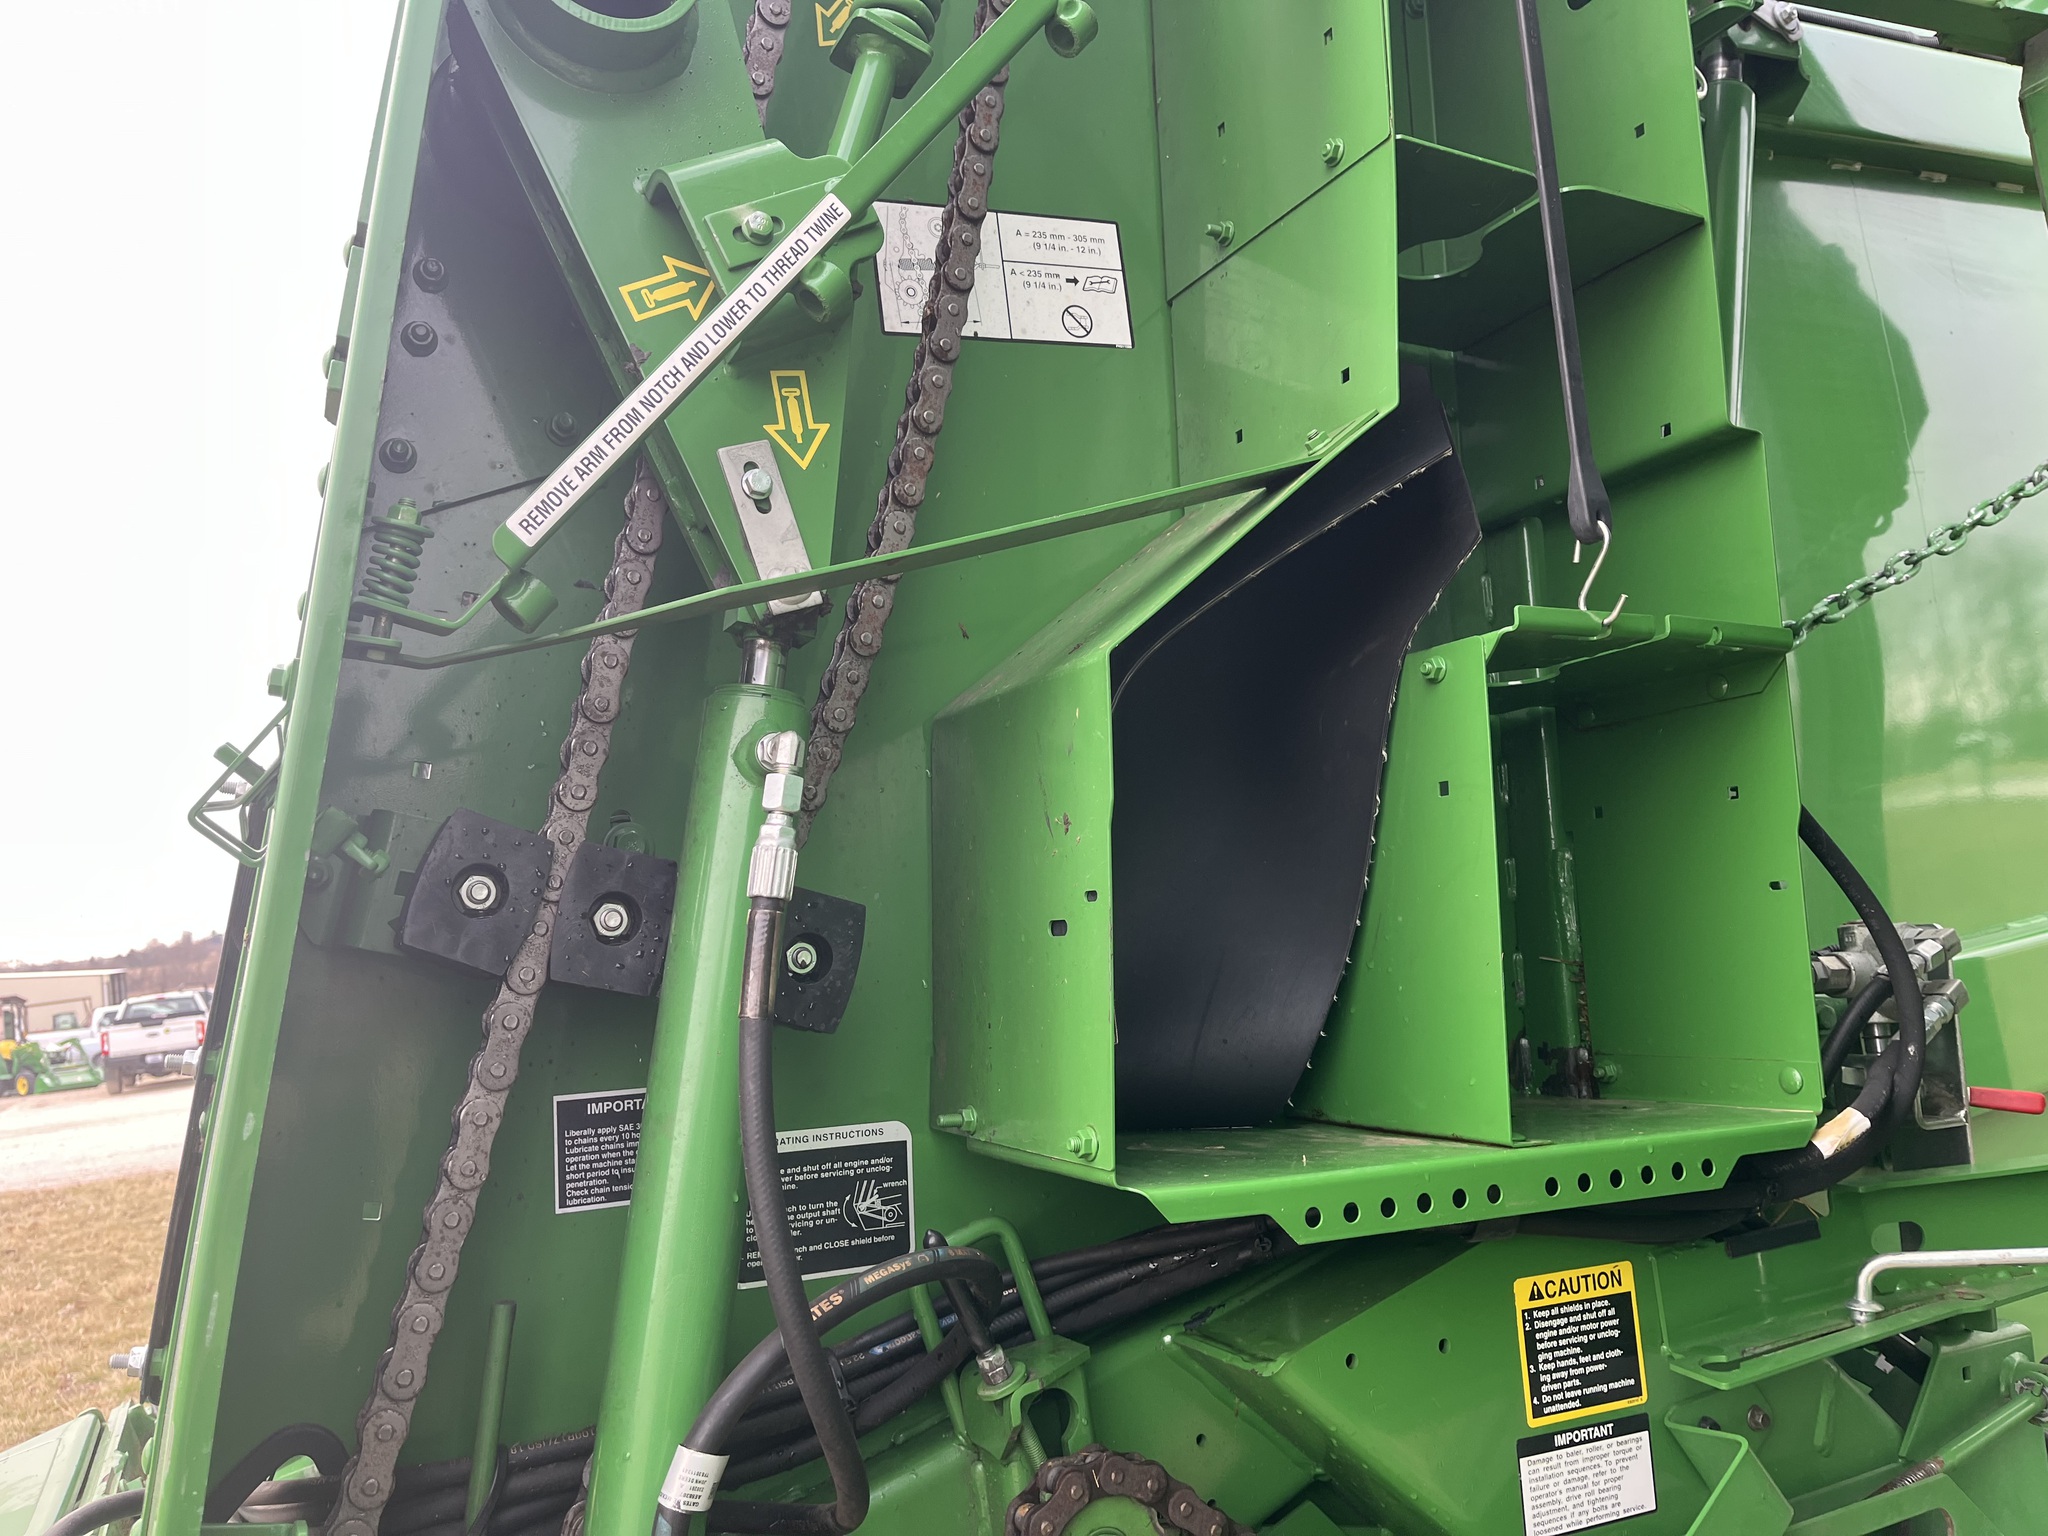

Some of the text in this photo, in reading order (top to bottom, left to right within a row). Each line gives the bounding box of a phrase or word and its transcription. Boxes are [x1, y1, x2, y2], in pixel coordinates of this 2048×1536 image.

[1016, 229, 1022, 237] A
[1032, 231, 1047, 239] 235
[1073, 234, 1087, 243] 305
[1033, 242, 1101, 256] (9 1/4 in. 12 in.)
[1010, 268, 1017, 276] A
[1027, 270, 1042, 278] 235
[1023, 281, 1031, 289] (9
[1048, 283, 1062, 292] in.)
[519, 203, 843, 535] REMOVE ARM FROM NOTCH AND LOWER TO THREAD TWINE
[565, 1123, 634, 1137] Liberally apply SAE
[813, 1128, 883, 1142] INSTRUCTIONS
[565, 1142, 624, 1154] Lubricate chains
[574, 1137, 598, 1145] chains
[565, 1154, 599, 1164] operation
[592, 1160, 622, 1168] machine
[566, 1172, 585, 1180] short
[587, 1169, 610, 1179] period
[787, 1166, 801, 1174] and
[803, 1164, 819, 1172] shut
[821, 1162, 831, 1170] off
[844, 1160, 869, 1169] engine
[795, 1173, 818, 1181] before
[821, 1169, 854, 1178] servicing
[866, 1165, 892, 1173] unclog-
[566, 1179, 608, 1189] penetration.
[566, 1188, 589, 1197] Check
[590, 1186, 610, 1194] chain
[566, 1196, 606, 1205] lubrication.
[796, 1211, 820, 1221] output
[822, 1208, 840, 1216] shaft
[809, 1243, 822, 1251] and
[824, 1240, 849, 1249] CLOSE
[851, 1237, 872, 1245] shield
[1545, 1270, 1622, 1298] CAUTION
[1533, 1310, 1550, 1318] Keep
[1551, 1307, 1559, 1315] all
[1560, 1304, 1583, 1314] shields
[1592, 1300, 1610, 1310] place.
[1534, 1317, 1568, 1329] Disengage
[1569, 1314, 1581, 1323] and
[1583, 1311, 1597, 1320] shut
[1598, 1309, 1606, 1318] off
[1535, 1319, 1619, 1340] engine and/or motor power
[1537, 1341, 1557, 1350] before
[1559, 1335, 1588, 1346] servicing
[1597, 1329, 1620, 1339] unclog-
[1538, 1347, 1582, 1362] ging machine.
[1539, 1349, 1623, 1371] Keep hands, feet and cloth-
[1540, 1363, 1607, 1382] ing away from power-
[1541, 1379, 1581, 1392] driven parts.
[1542, 1378, 1635, 1403] Do not leave running machine
[1543, 1399, 1581, 1414] unattended.
[1554, 1423, 1613, 1446] IMPORTANT
[1527, 1437, 1642, 1466] Damage baler, roller, bearings
[1543, 1447, 1632, 1471] result from improper torque
[1529, 1454, 1638, 1484] installation sequences. prevent
[1530, 1470, 1607, 1493] failure damage, refer
[1531, 1475, 1623, 1502] operator's manual proper
[1532, 1498, 1563, 1510] assembly,
[1566, 1494, 1581, 1502] drive
[1598, 1484, 1621, 1494] bearing
[1532, 1494, 1618, 1519] adjustment, and tightening
[1533, 1505, 1608, 1528] sequences bolts
[1534, 1504, 1646, 1536] loosened while performing service.
